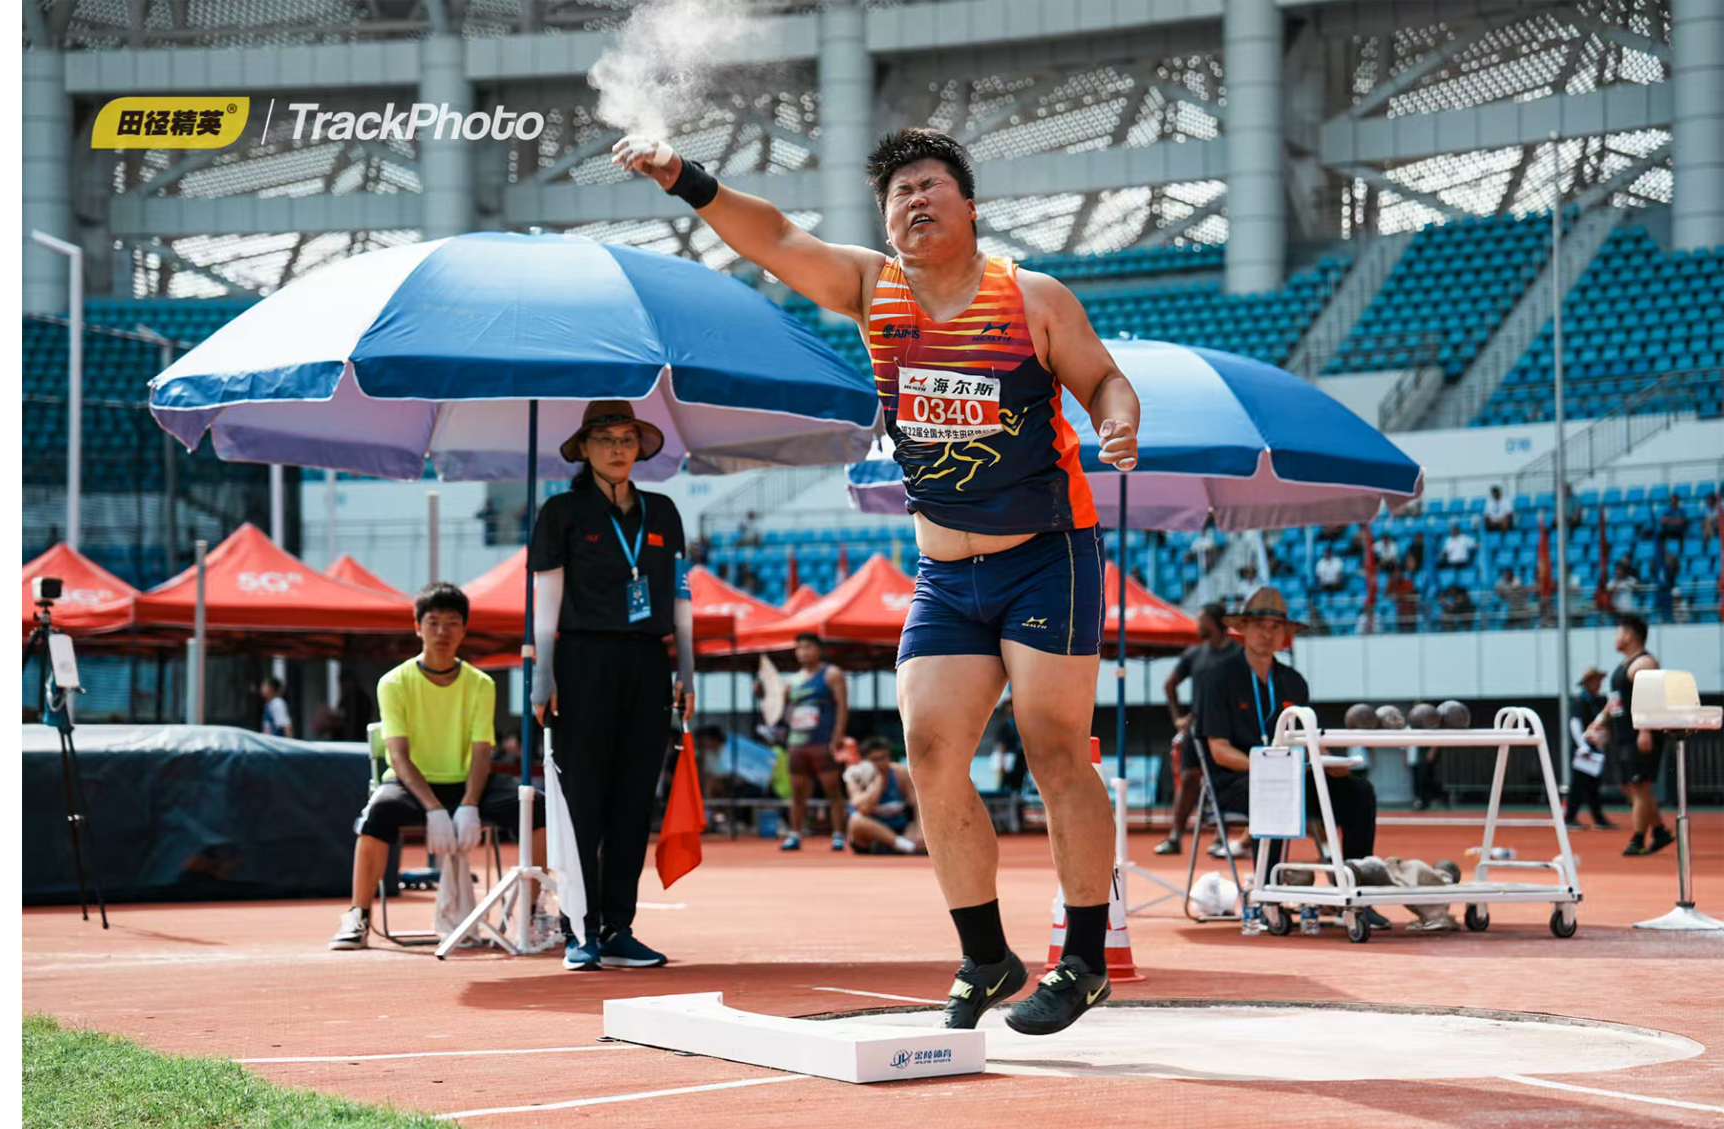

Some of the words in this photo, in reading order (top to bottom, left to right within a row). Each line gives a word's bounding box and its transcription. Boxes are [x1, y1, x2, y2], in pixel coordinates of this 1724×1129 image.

[932, 377, 995, 397] 海尔斯
[913, 396, 984, 425] 0340
